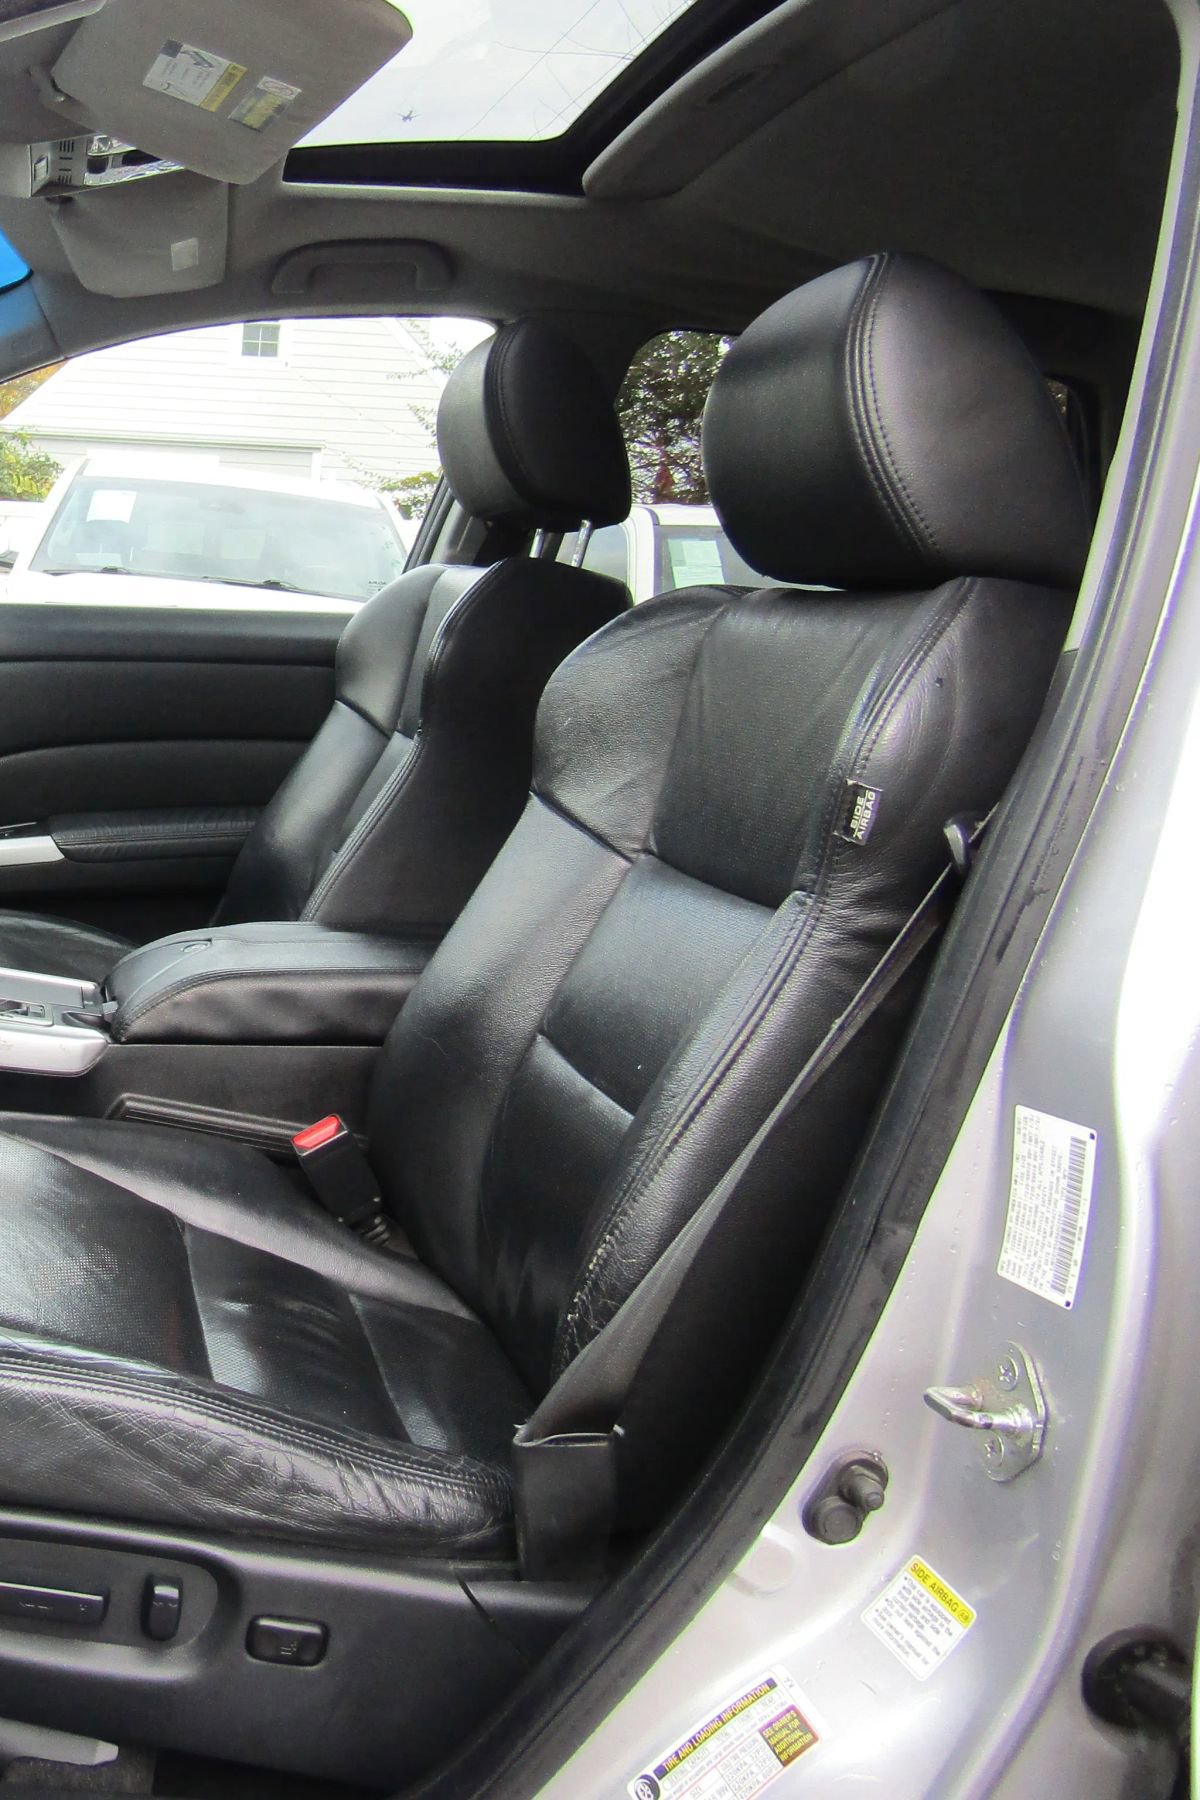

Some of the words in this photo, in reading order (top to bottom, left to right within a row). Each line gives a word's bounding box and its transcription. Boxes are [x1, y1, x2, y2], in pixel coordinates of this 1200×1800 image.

[850, 796, 864, 828] SIDE
[856, 790, 876, 839] AIRBAG
[908, 1561, 931, 1584] SIDE
[928, 1580, 960, 1613] AIRBAG
[662, 1754, 680, 1771] TIRE
[675, 1741, 694, 1758] AND
[690, 1717, 723, 1746] LOADING
[719, 1679, 770, 1724] INFORMATION
[762, 1727, 774, 1738] SEE
[767, 1726, 790, 1745] MANUAL
[787, 1717, 801, 1730] FOR
[773, 1728, 803, 1753] ADDITIONAL
[778, 1732, 814, 1761] INFORMATION
